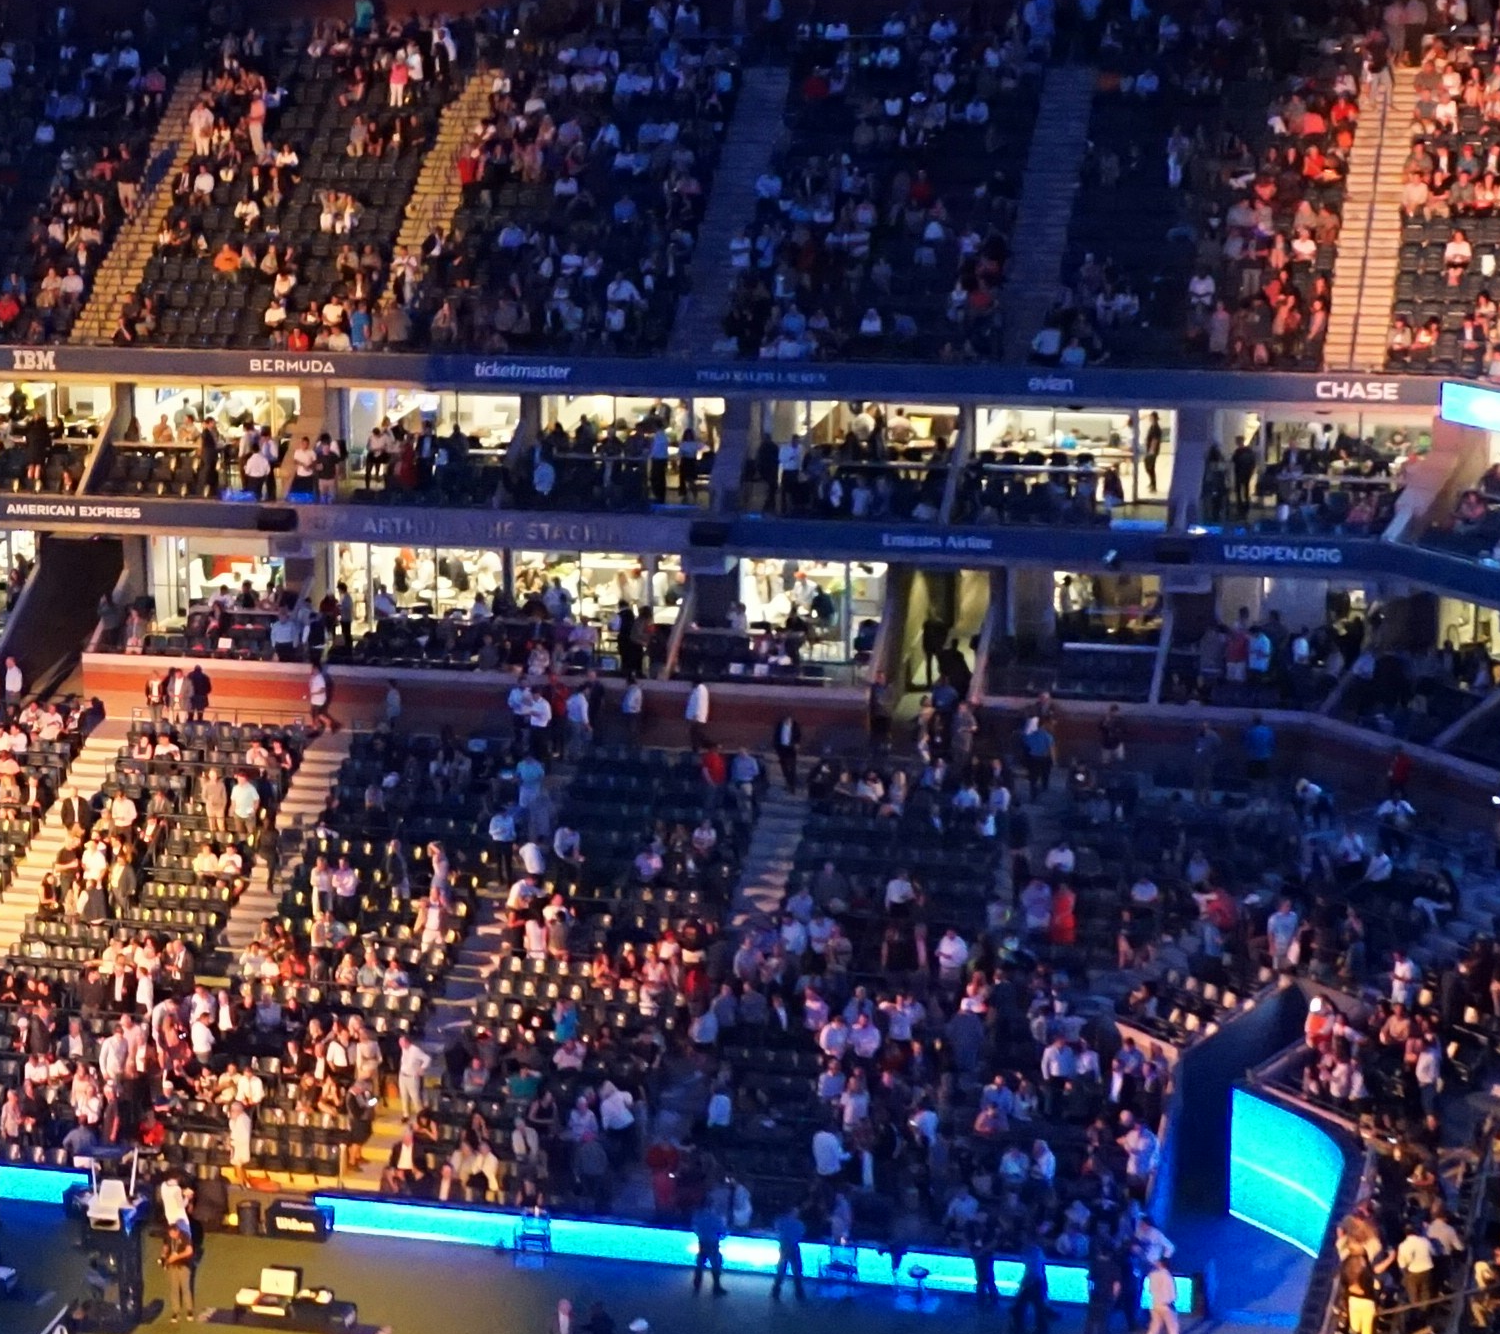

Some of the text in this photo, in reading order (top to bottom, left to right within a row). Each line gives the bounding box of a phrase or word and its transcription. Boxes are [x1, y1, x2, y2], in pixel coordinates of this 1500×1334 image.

[12, 350, 56, 371] IBM
[249, 358, 335, 374] BERMUDA
[474, 362, 572, 379] ticketmaster
[1028, 375, 1075, 393] evian
[1315, 380, 1399, 401] CHASE
[5, 503, 141, 520] AMERICAN EXPRESS
[1223, 542, 1343, 564] USOPEN.ORG
